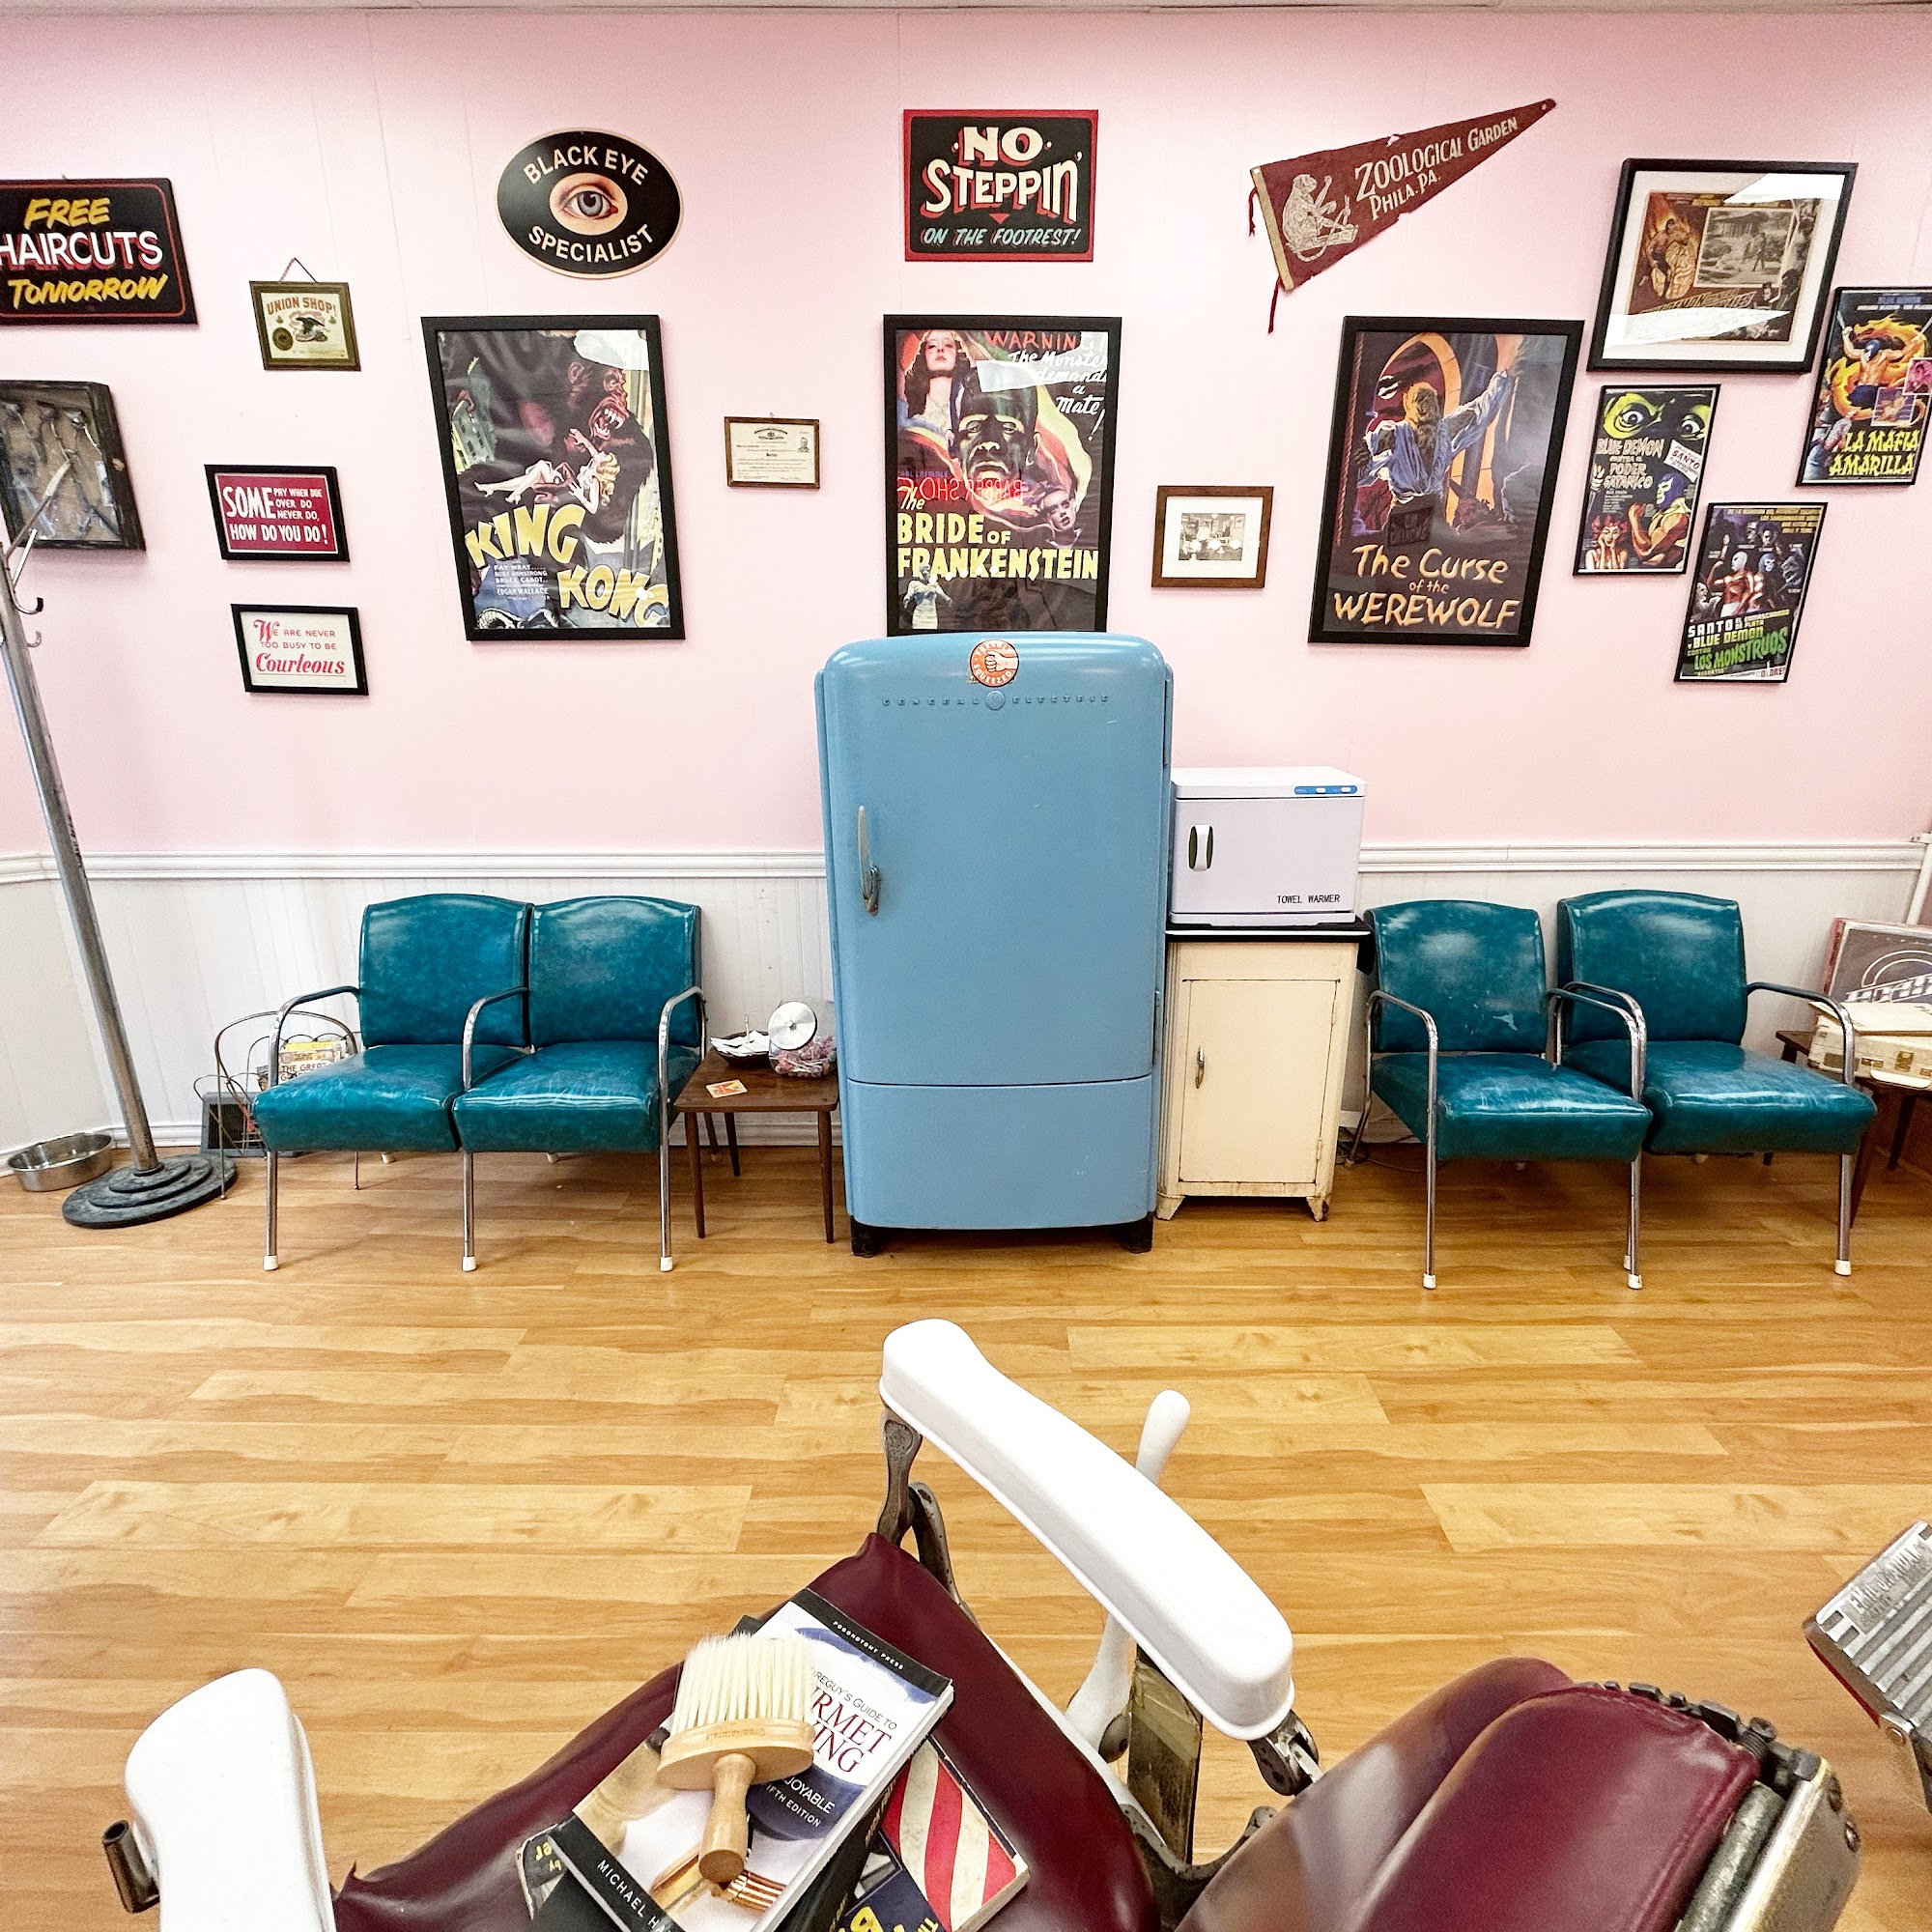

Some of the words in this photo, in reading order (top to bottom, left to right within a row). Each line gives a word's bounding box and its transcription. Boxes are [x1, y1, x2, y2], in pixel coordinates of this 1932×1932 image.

[959, 127, 1044, 164] NO
[523, 145, 599, 185] BLACK
[605, 148, 648, 185] EYE
[1354, 136, 1463, 202] ZOOLOGICAL
[1467, 116, 1518, 152] GARDEN
[1370, 181, 1419, 220] PHILA.
[1418, 169, 1441, 193] PA.
[22, 197, 111, 231] FREE
[527, 223, 653, 263] SPECIALIST
[922, 227, 950, 246] ON
[952, 227, 987, 246] THE
[989, 227, 1082, 247] FOOTREST!
[0, 230, 164, 270] HAIRCUTS
[8, 272, 169, 309] TOMORROW
[267, 297, 300, 316] UNION
[982, 329, 1077, 350] WARNIN
[1009, 349, 1037, 364] The
[1072, 384, 1085, 395] a
[1623, 437, 1664, 459] DEMON
[1845, 429, 1865, 453] LA
[1864, 429, 1920, 453] MAFIA
[1671, 449, 1700, 470] SANTO
[1829, 452, 1916, 476] AMARILLA
[222, 485, 276, 520] SOME
[289, 488, 310, 498] WHEN
[275, 498, 298, 510] OVER
[299, 499, 313, 510] DO
[897, 485, 925, 511] The
[276, 508, 303, 521] NEVER
[229, 523, 257, 542] HOW
[261, 524, 277, 542] DO
[277, 525, 301, 543] YOU
[464, 503, 586, 571] KING
[897, 512, 985, 546] BRIDE
[986, 529, 1011, 545] OF
[897, 546, 1098, 582] FRANKENSTEIN
[1351, 544, 1411, 580] The
[1419, 547, 1509, 585] Curse
[556, 563, 669, 628] KONG
[1408, 579, 1424, 595] of
[1427, 580, 1450, 595] the
[1333, 590, 1521, 630] WEREWOLF
[283, 627, 302, 639] ARE
[304, 627, 336, 639] NEVER
[1688, 618, 1734, 639] SANTO
[1692, 634, 1720, 649] BLUE
[1723, 626, 1764, 644] DEMON
[260, 639, 279, 650] TOO
[282, 639, 306, 650] BUSY
[309, 640, 322, 650] TO
[324, 640, 337, 651] BE
[1693, 653, 1713, 671] LOS
[1713, 626, 1789, 669] MONSTRUOS
[255, 652, 345, 675] Courteous
[973, 663, 1012, 684] SQUEEZED
[881, 696, 980, 706] GENERAL
[1276, 895, 1303, 904] TOWEL
[1307, 894, 1341, 904] WARMER
[281, 1064, 298, 1072] THE
[880, 1652, 904, 1670] PRESS
[811, 1671, 853, 1702] REGUY'S
[852, 1697, 884, 1722] GUIDE
[883, 1718, 897, 1730] TO
[811, 1686, 893, 1753] RMET
[812, 1719, 866, 1773] ING
[765, 1783, 787, 1804] IFTH
[785, 1799, 822, 1828] EDITION
[783, 1776, 836, 1814] JOYABLE
[597, 1859, 646, 1918] MICHAEL
[646, 1915, 673, 1932] HA
